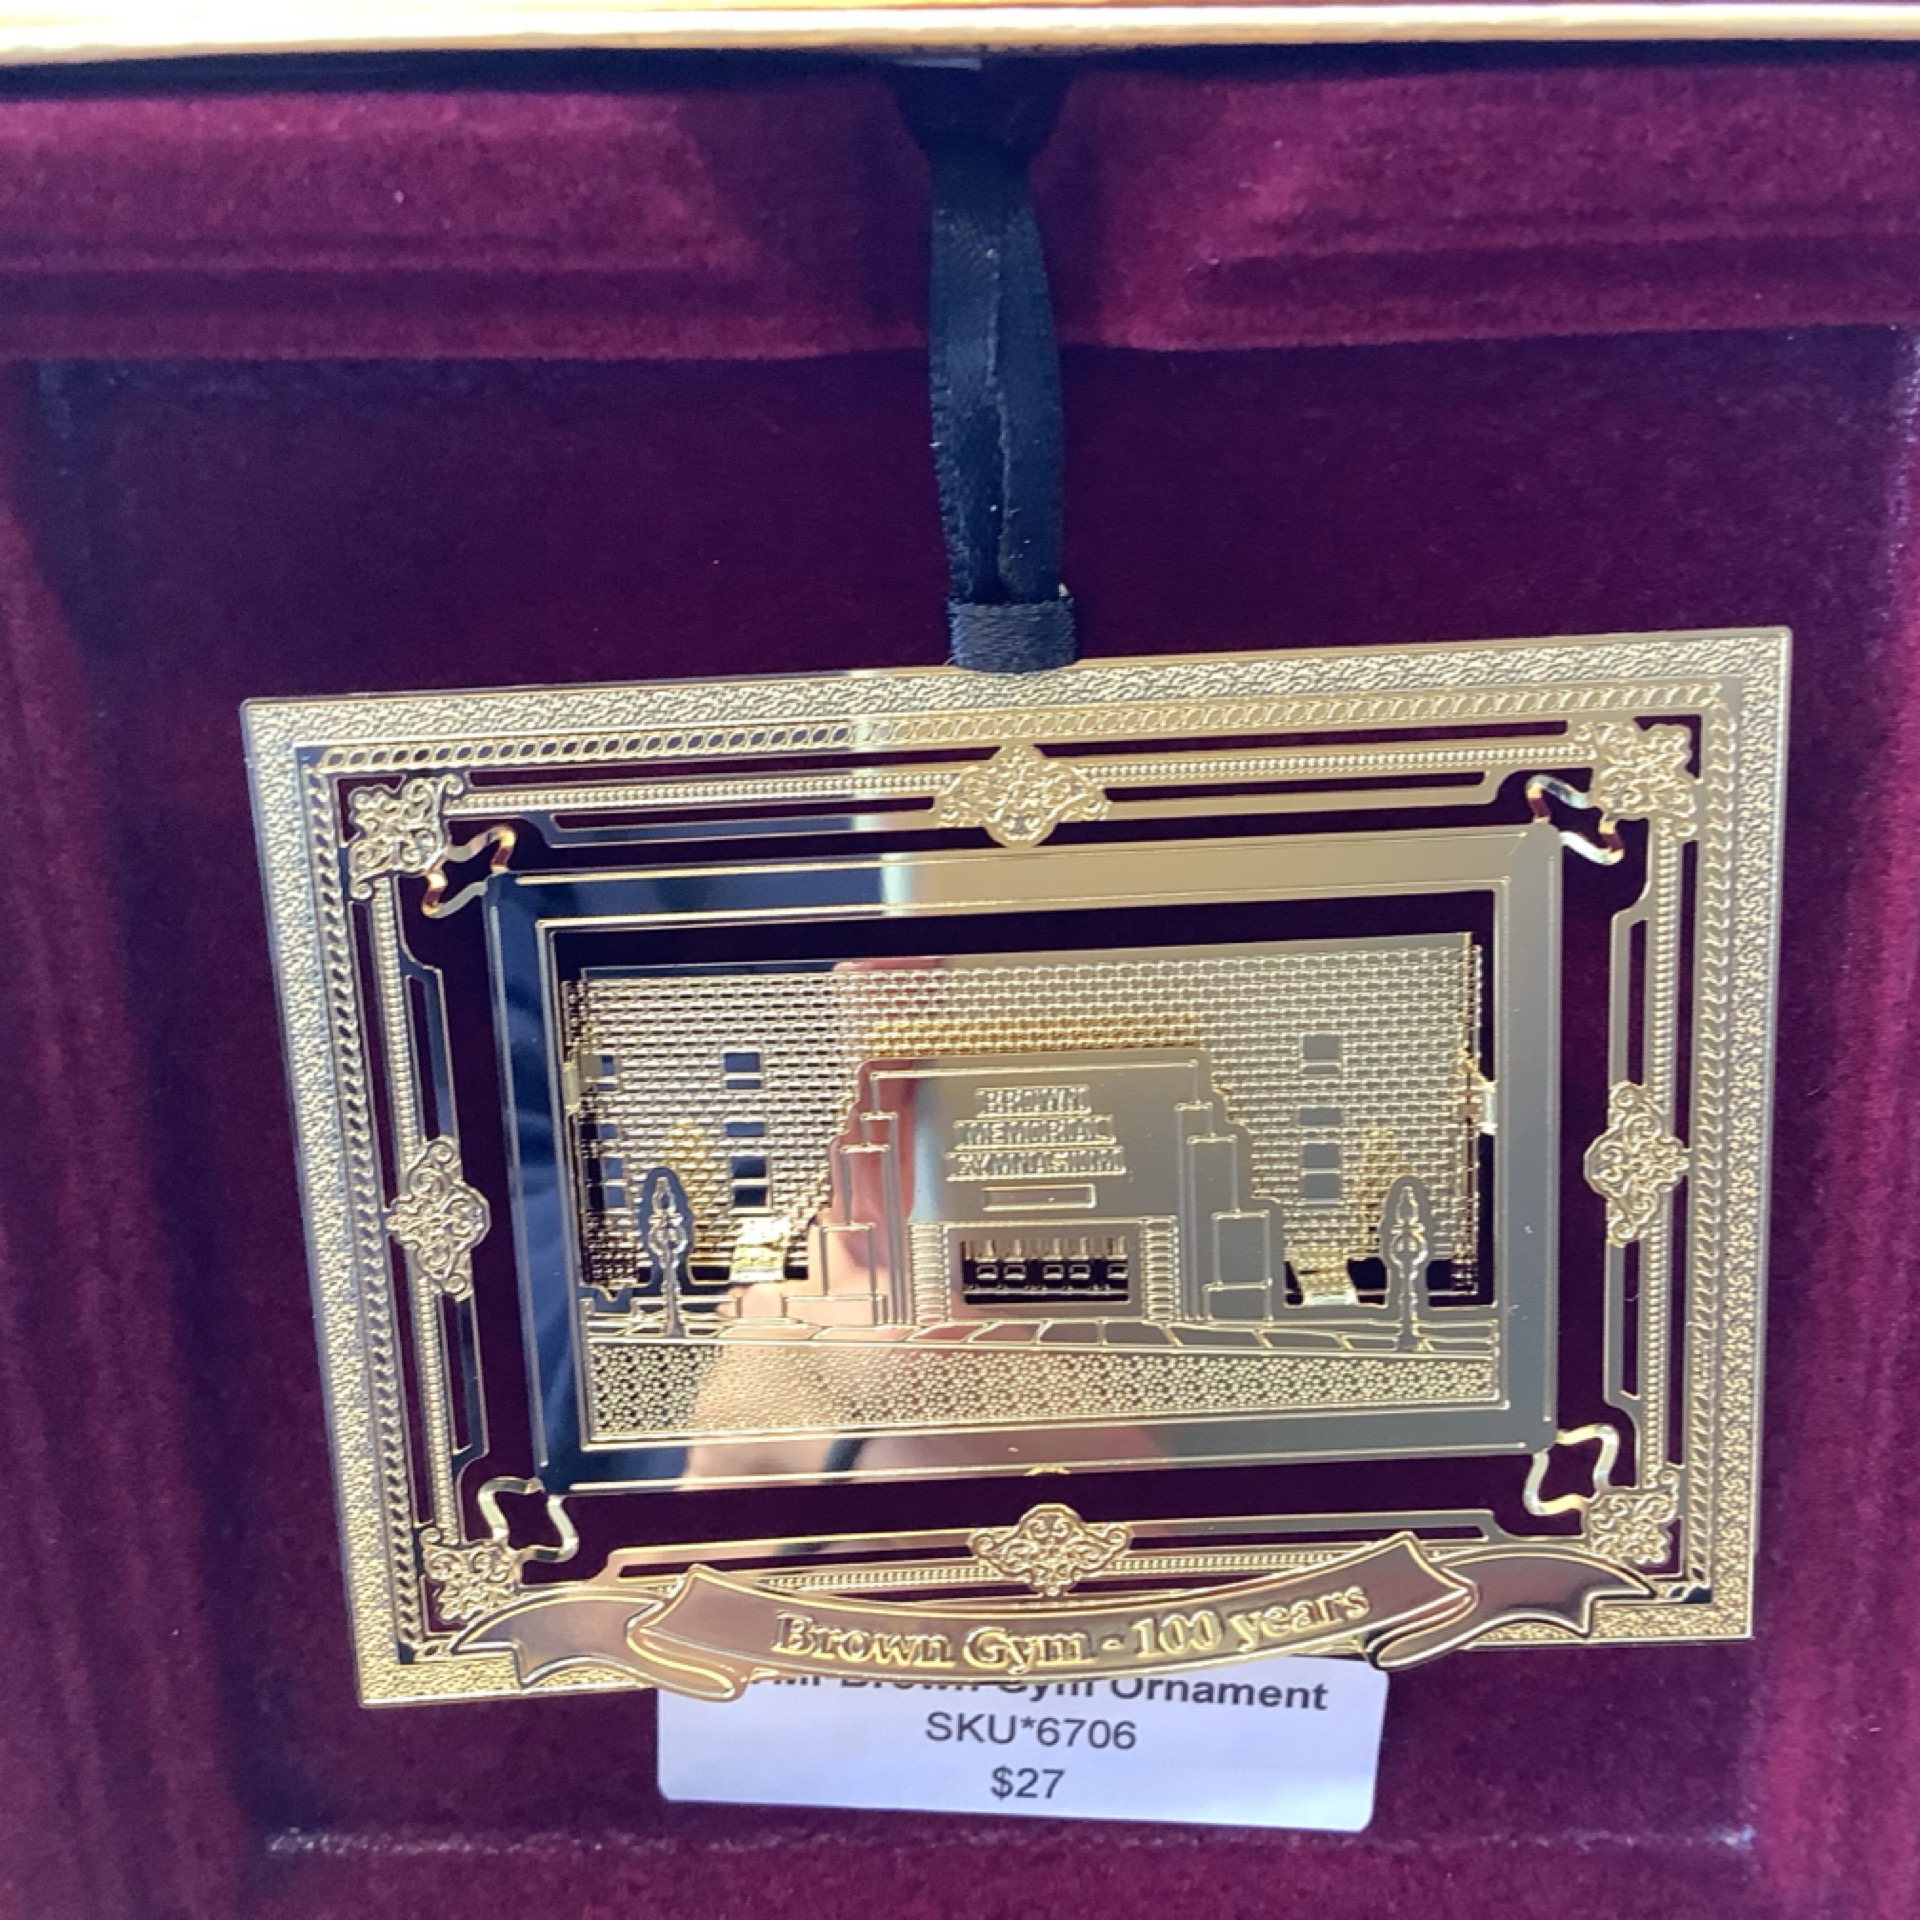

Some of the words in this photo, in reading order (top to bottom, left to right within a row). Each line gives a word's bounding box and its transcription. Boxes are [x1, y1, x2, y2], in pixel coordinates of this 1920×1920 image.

[772, 1610, 956, 1668] Brown
[962, 1625, 1097, 1675] Gym
[1130, 1608, 1225, 1659] 100
[1226, 1584, 1371, 1653] years
[1110, 1677, 1329, 1711] Ornament
[990, 1765, 1065, 1801] $27
